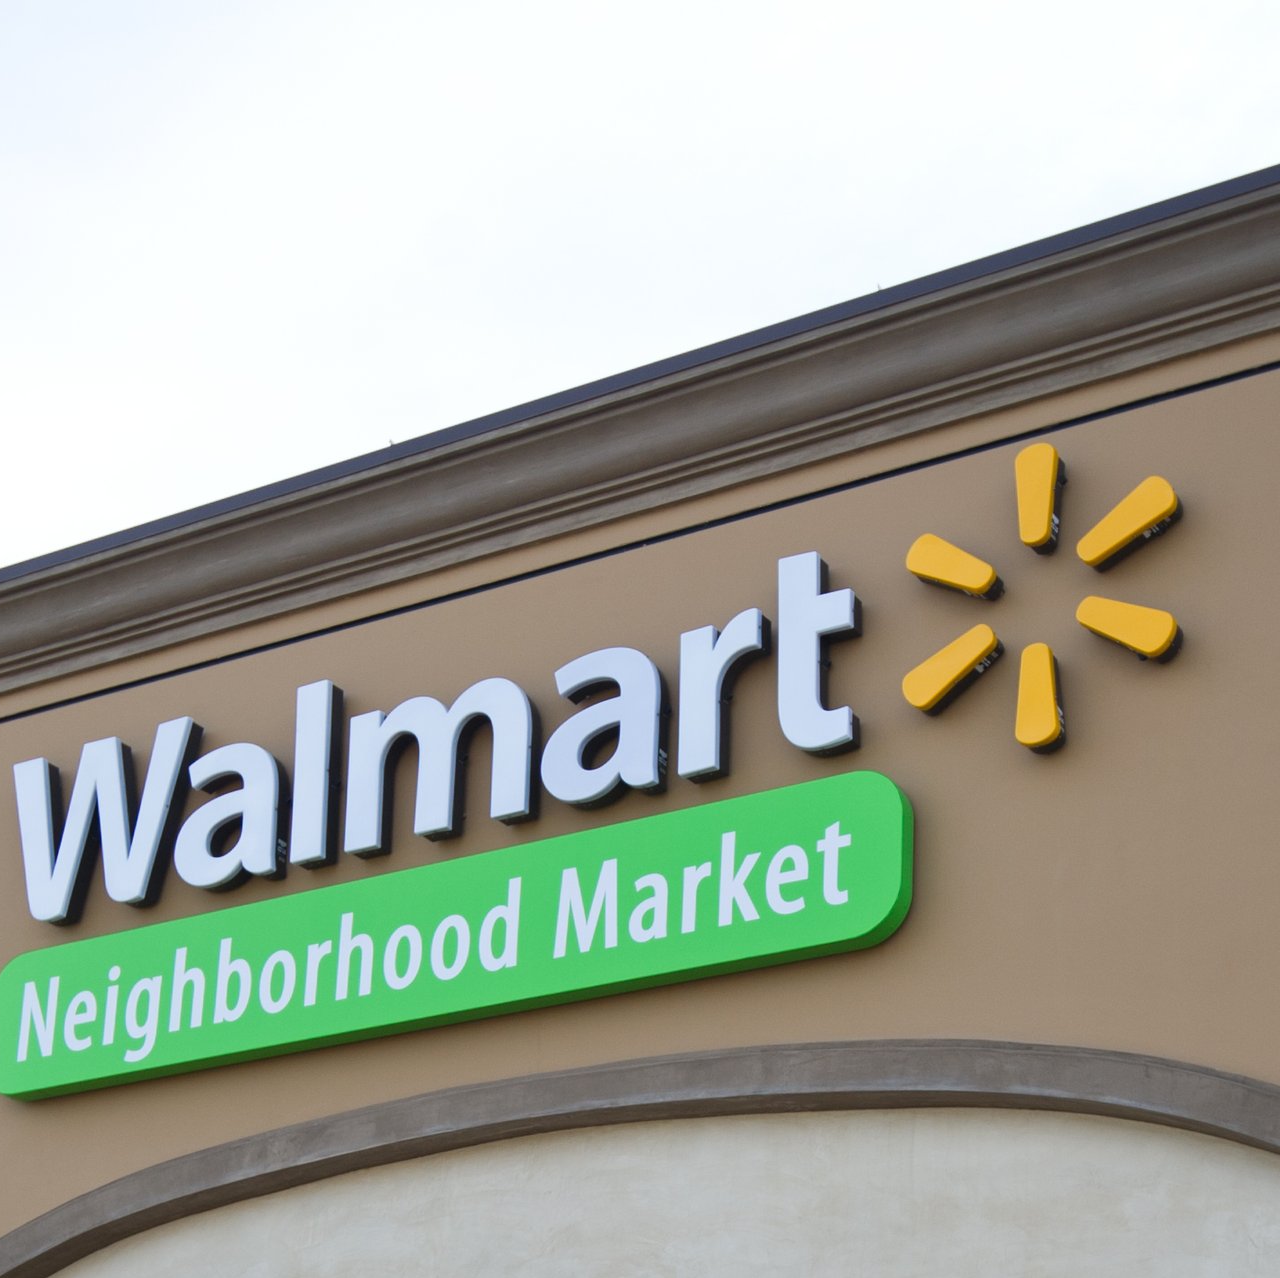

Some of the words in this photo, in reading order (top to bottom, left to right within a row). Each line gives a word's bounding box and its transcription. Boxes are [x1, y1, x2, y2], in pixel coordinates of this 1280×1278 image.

[11, 549, 859, 925] Walmart
[16, 875, 523, 1064] Neighborhood
[552, 821, 853, 961] Market
